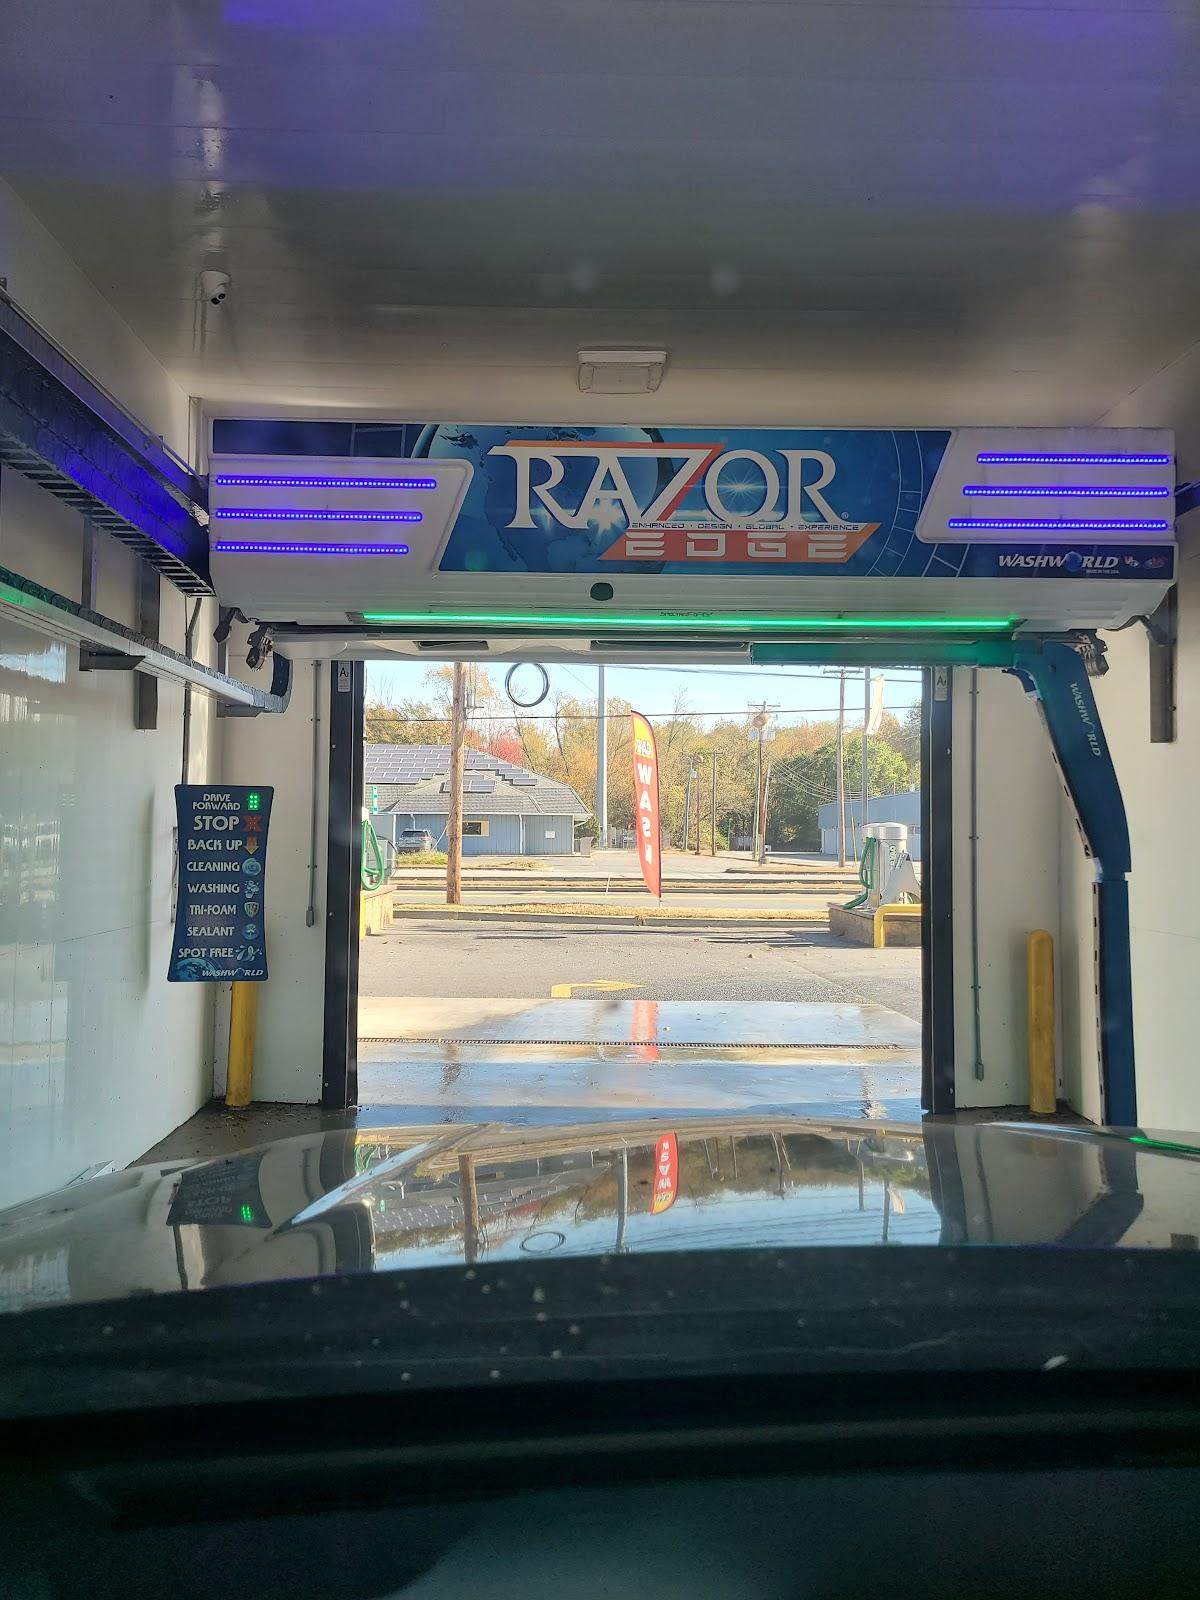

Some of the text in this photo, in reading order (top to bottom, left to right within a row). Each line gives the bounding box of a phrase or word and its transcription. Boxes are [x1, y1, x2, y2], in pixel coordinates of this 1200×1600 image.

[626, 532, 848, 559] EDGE
[203, 793, 231, 802] DRIVE
[192, 802, 241, 811] FORWARD
[193, 815, 240, 831] STOP
[187, 839, 243, 851] BACK UP
[186, 862, 240, 872] CLEANING
[186, 883, 240, 894] WASHING
[189, 904, 237, 915] TRI-FOAM
[186, 926, 235, 937] SEALANT
[178, 947, 234, 958] SPOT FREE
